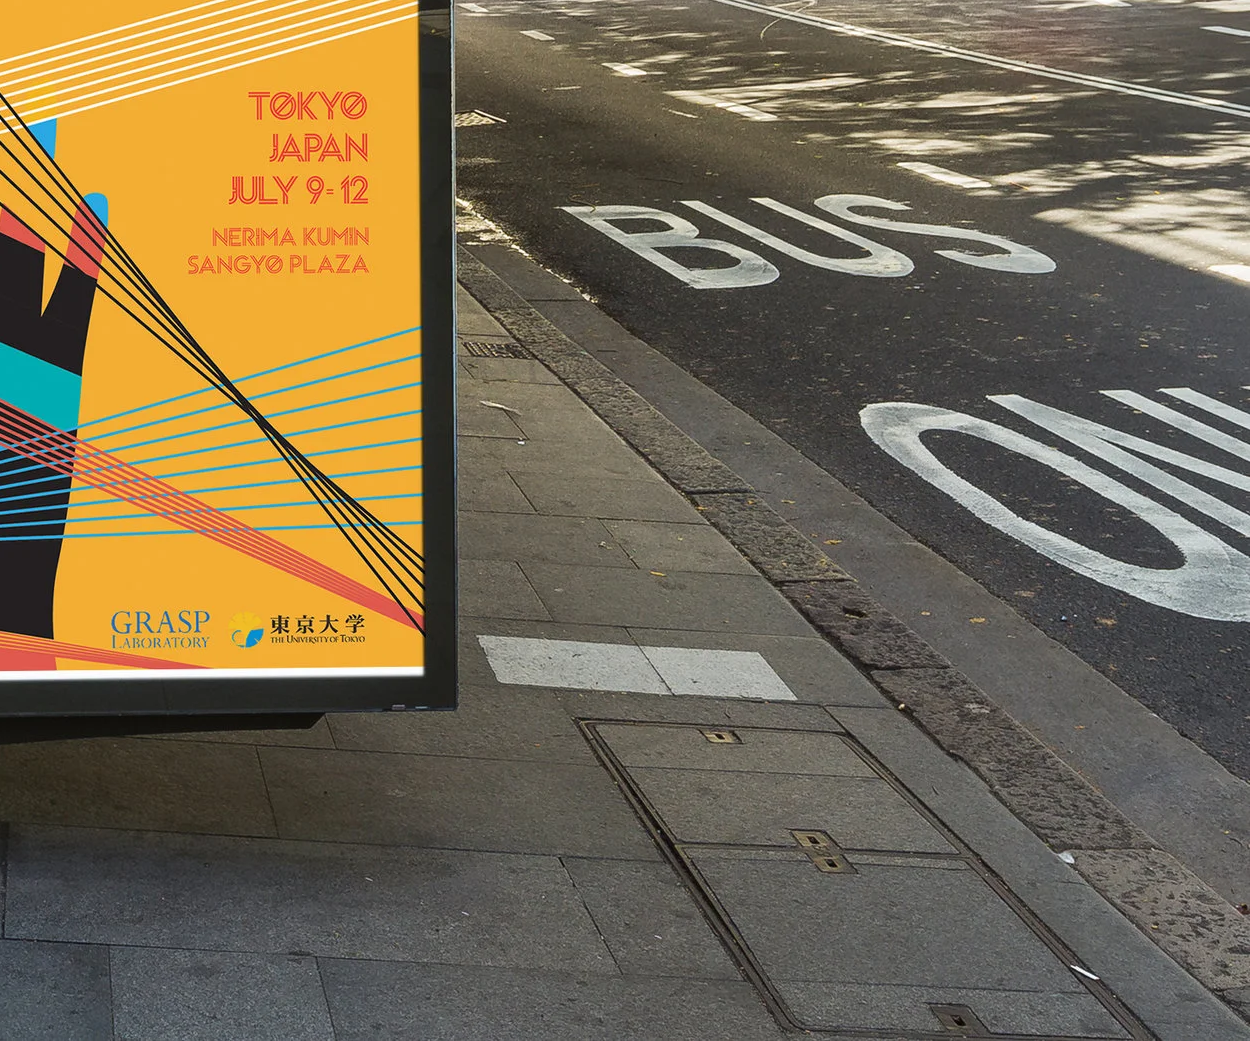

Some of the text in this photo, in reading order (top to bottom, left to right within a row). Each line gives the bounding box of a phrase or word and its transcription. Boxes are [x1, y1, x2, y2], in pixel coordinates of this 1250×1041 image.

[269, 133, 368, 162] JAPAN
[229, 175, 298, 204] JULY
[212, 227, 369, 246] NERIMA KUMIN
[556, 194, 1056, 289] BUS
[290, 254, 369, 274] PLAZA
[110, 610, 211, 634] GRASP
[270, 614, 366, 634] 東京大学
[111, 635, 210, 649] LABORATORY
[270, 636, 285, 644] THE
[286, 635, 329, 644] UNIVERSITY
[339, 634, 366, 644] TOKYO
